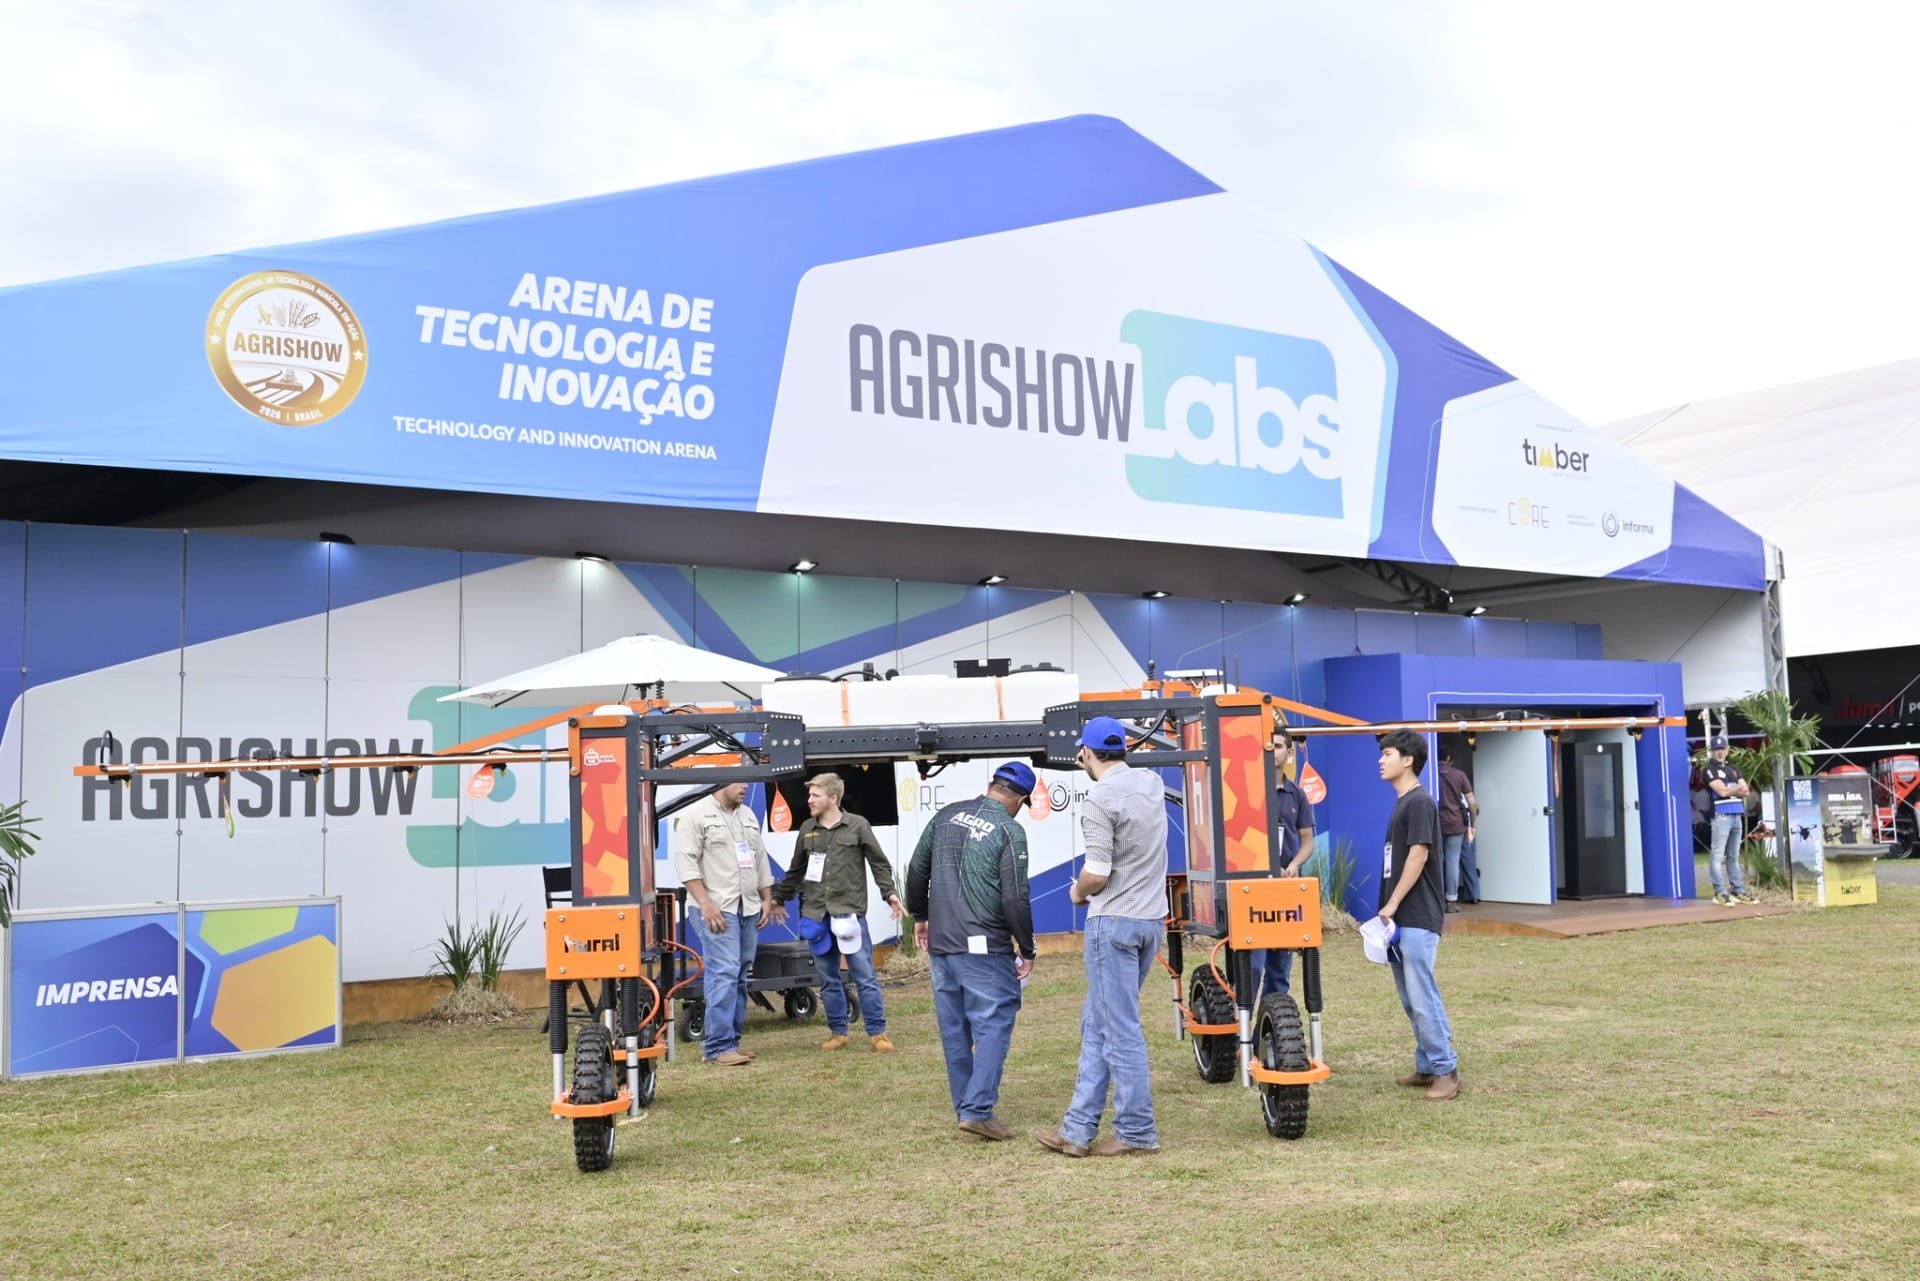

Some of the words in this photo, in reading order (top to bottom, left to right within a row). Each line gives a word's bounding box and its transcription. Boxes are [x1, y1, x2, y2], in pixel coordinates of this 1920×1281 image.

[509, 272, 653, 327] ARENA
[660, 296, 715, 333] DE
[234, 331, 343, 363] AGRISHOW
[415, 305, 683, 372] TECNOLOGIA
[689, 342, 715, 376] E
[294, 408, 323, 422] BRASIL
[499, 362, 715, 426] INOVAÇÃO
[849, 323, 1135, 444] AGRISHOW
[1119, 340, 1343, 480] Labs
[393, 415, 515, 444] TECHNOLOGY
[517, 426, 556, 447] AND
[558, 431, 661, 457] INNOVATION
[664, 441, 717, 461] ARENA
[1622, 519, 1655, 535] informa
[81, 735, 425, 822] AGRISHOW
[1248, 904, 1304, 924] hural
[35, 974, 179, 1007] IMPRENSA
